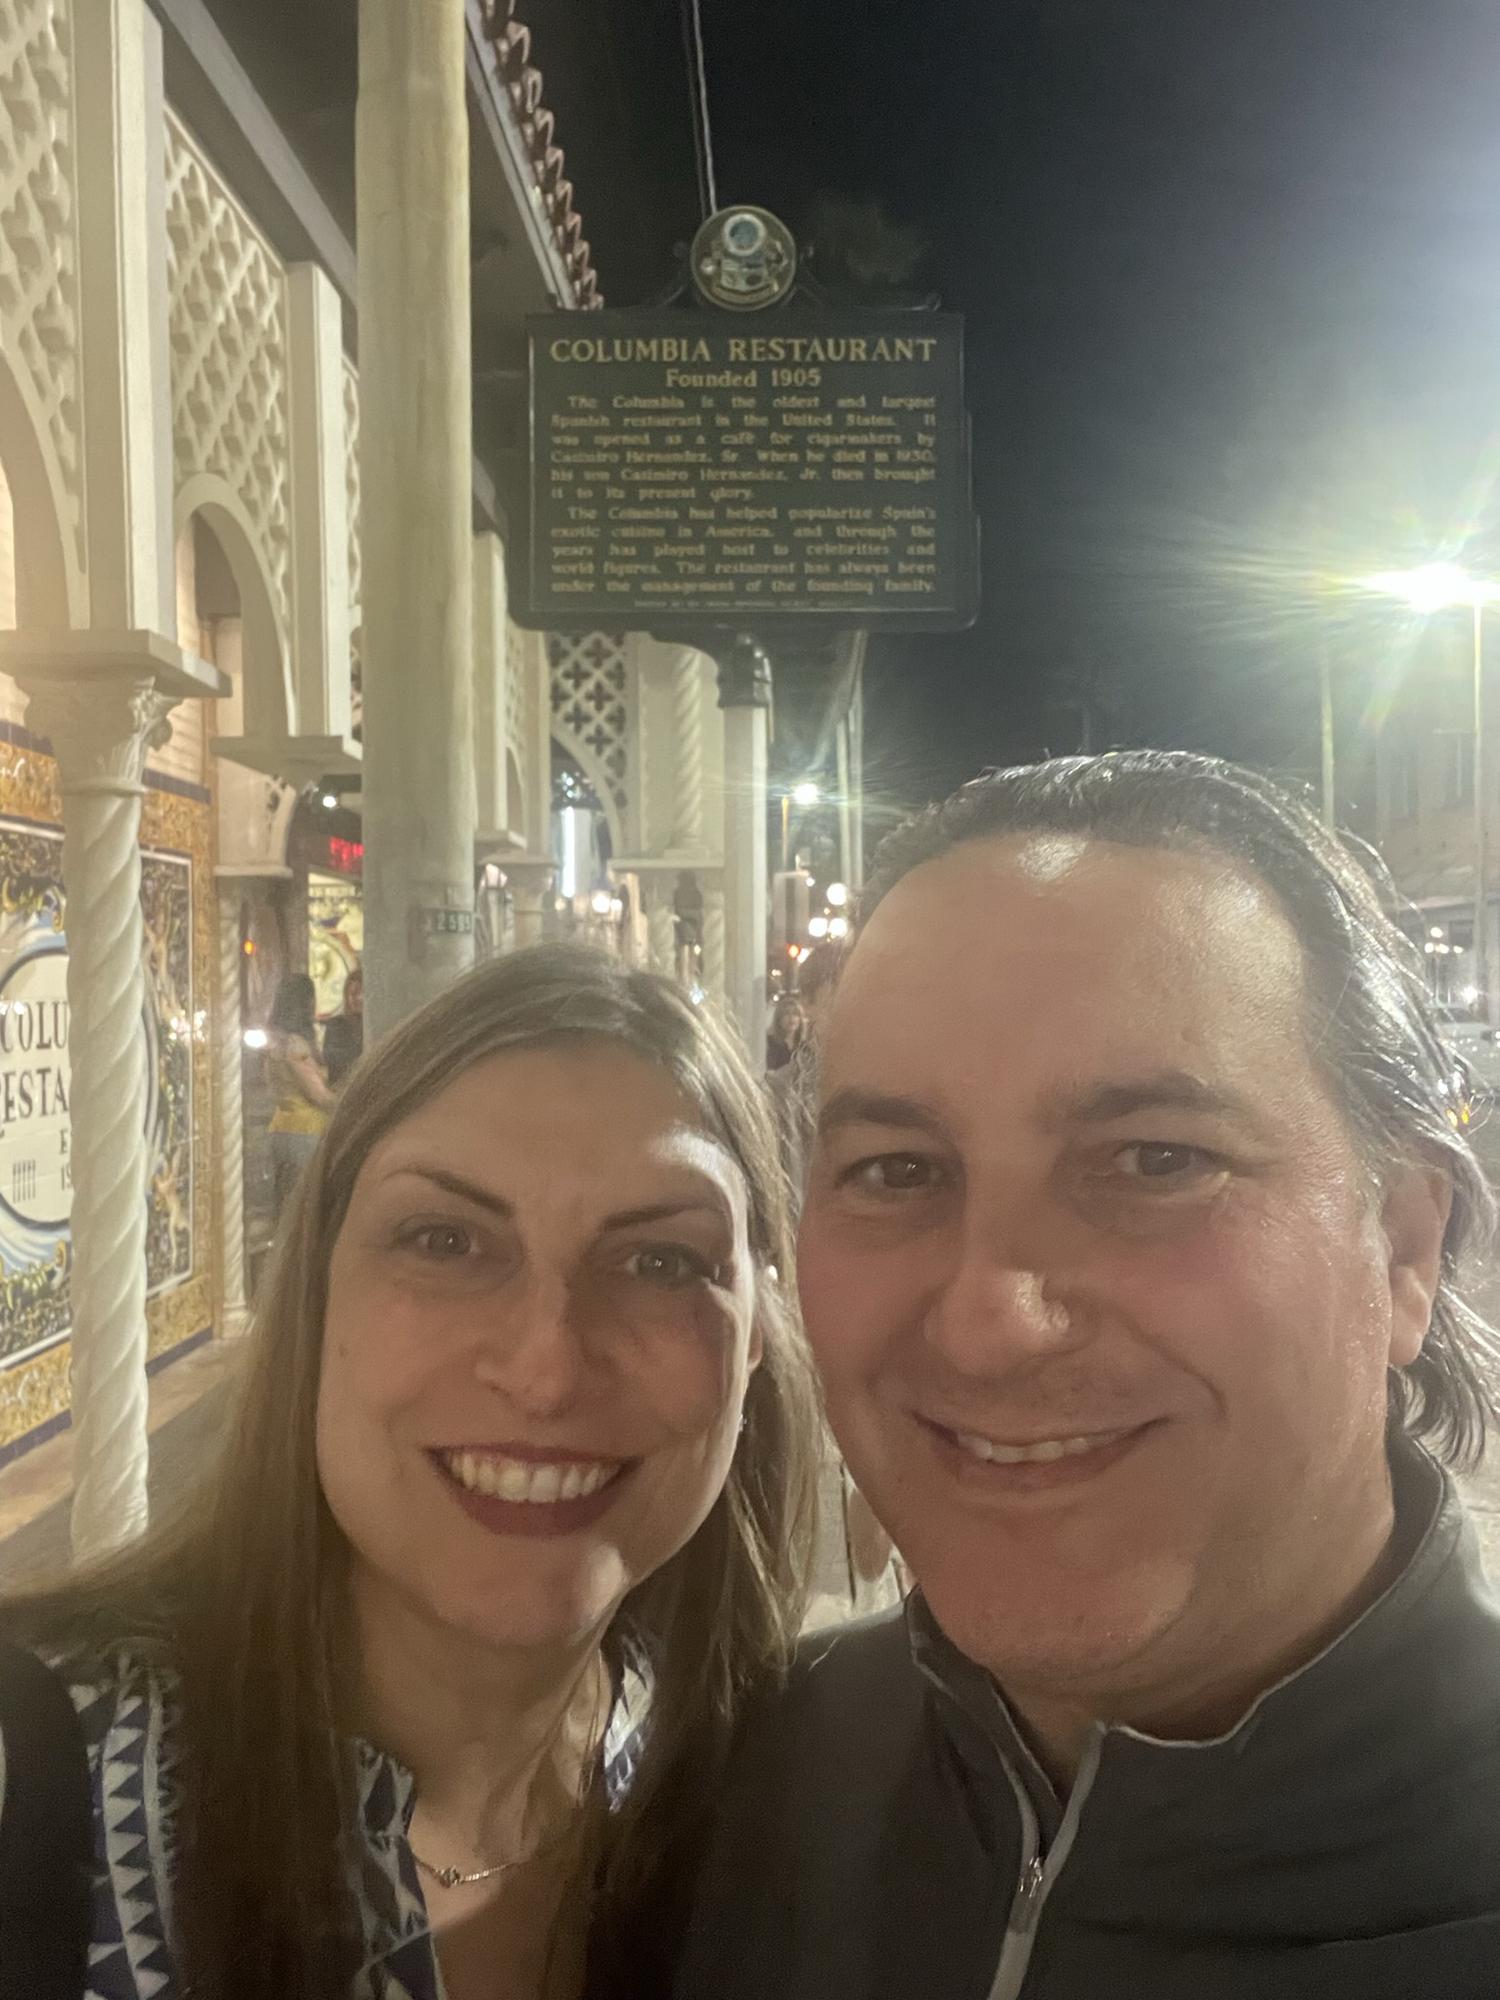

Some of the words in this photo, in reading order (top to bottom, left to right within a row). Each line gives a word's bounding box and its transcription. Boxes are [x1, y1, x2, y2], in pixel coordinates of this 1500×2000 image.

[549, 338, 711, 362] COLUMBIA
[729, 338, 937, 362] RESTAURANT
[666, 368, 757, 388] Founded
[772, 368, 821, 388] 1905
[568, 395, 597, 409] The
[612, 395, 684, 409] Columbia
[731, 395, 756, 409] the
[773, 395, 819, 409] oldest
[837, 395, 866, 409] and
[882, 395, 935, 412] largest
[551, 412, 609, 430] Spanish
[622, 412, 702, 427] restaurant
[744, 412, 768, 427] the
[782, 412, 833, 427] United
[552, 434, 579, 445] was
[594, 431, 650, 448] opened
[770, 431, 792, 445] for
[917, 431, 935, 448] by
[757, 449, 798, 463] When
[806, 449, 825, 463] he
[832, 449, 866, 463] died
[551, 468, 573, 482] his
[584, 471, 610, 482] son
[832, 468, 864, 482] then
[606, 486, 625, 500] its
[639, 486, 696, 503] present
[568, 505, 597, 519] The
[608, 505, 678, 519] Columbia
[689, 505, 715, 519] has
[726, 505, 778, 522] helped
[550, 525, 600, 537] exotic
[793, 525, 822, 537] and
[836, 525, 897, 541] through
[911, 525, 935, 537] the
[552, 545, 593, 559] years
[610, 542, 636, 555] has
[654, 542, 705, 558] played
[723, 542, 755, 555] host
[806, 542, 890, 555] celebrities
[906, 542, 935, 555] and
[552, 560, 594, 573] world
[676, 560, 706, 573] The
[715, 560, 795, 573] restaurant
[804, 560, 830, 573] has
[898, 560, 935, 573] been
[551, 579, 595, 592] under
[606, 579, 630, 592] the
[771, 579, 796, 592] the
[807, 579, 874, 595] founding
[0, 1065, 70, 1124] ESTA
